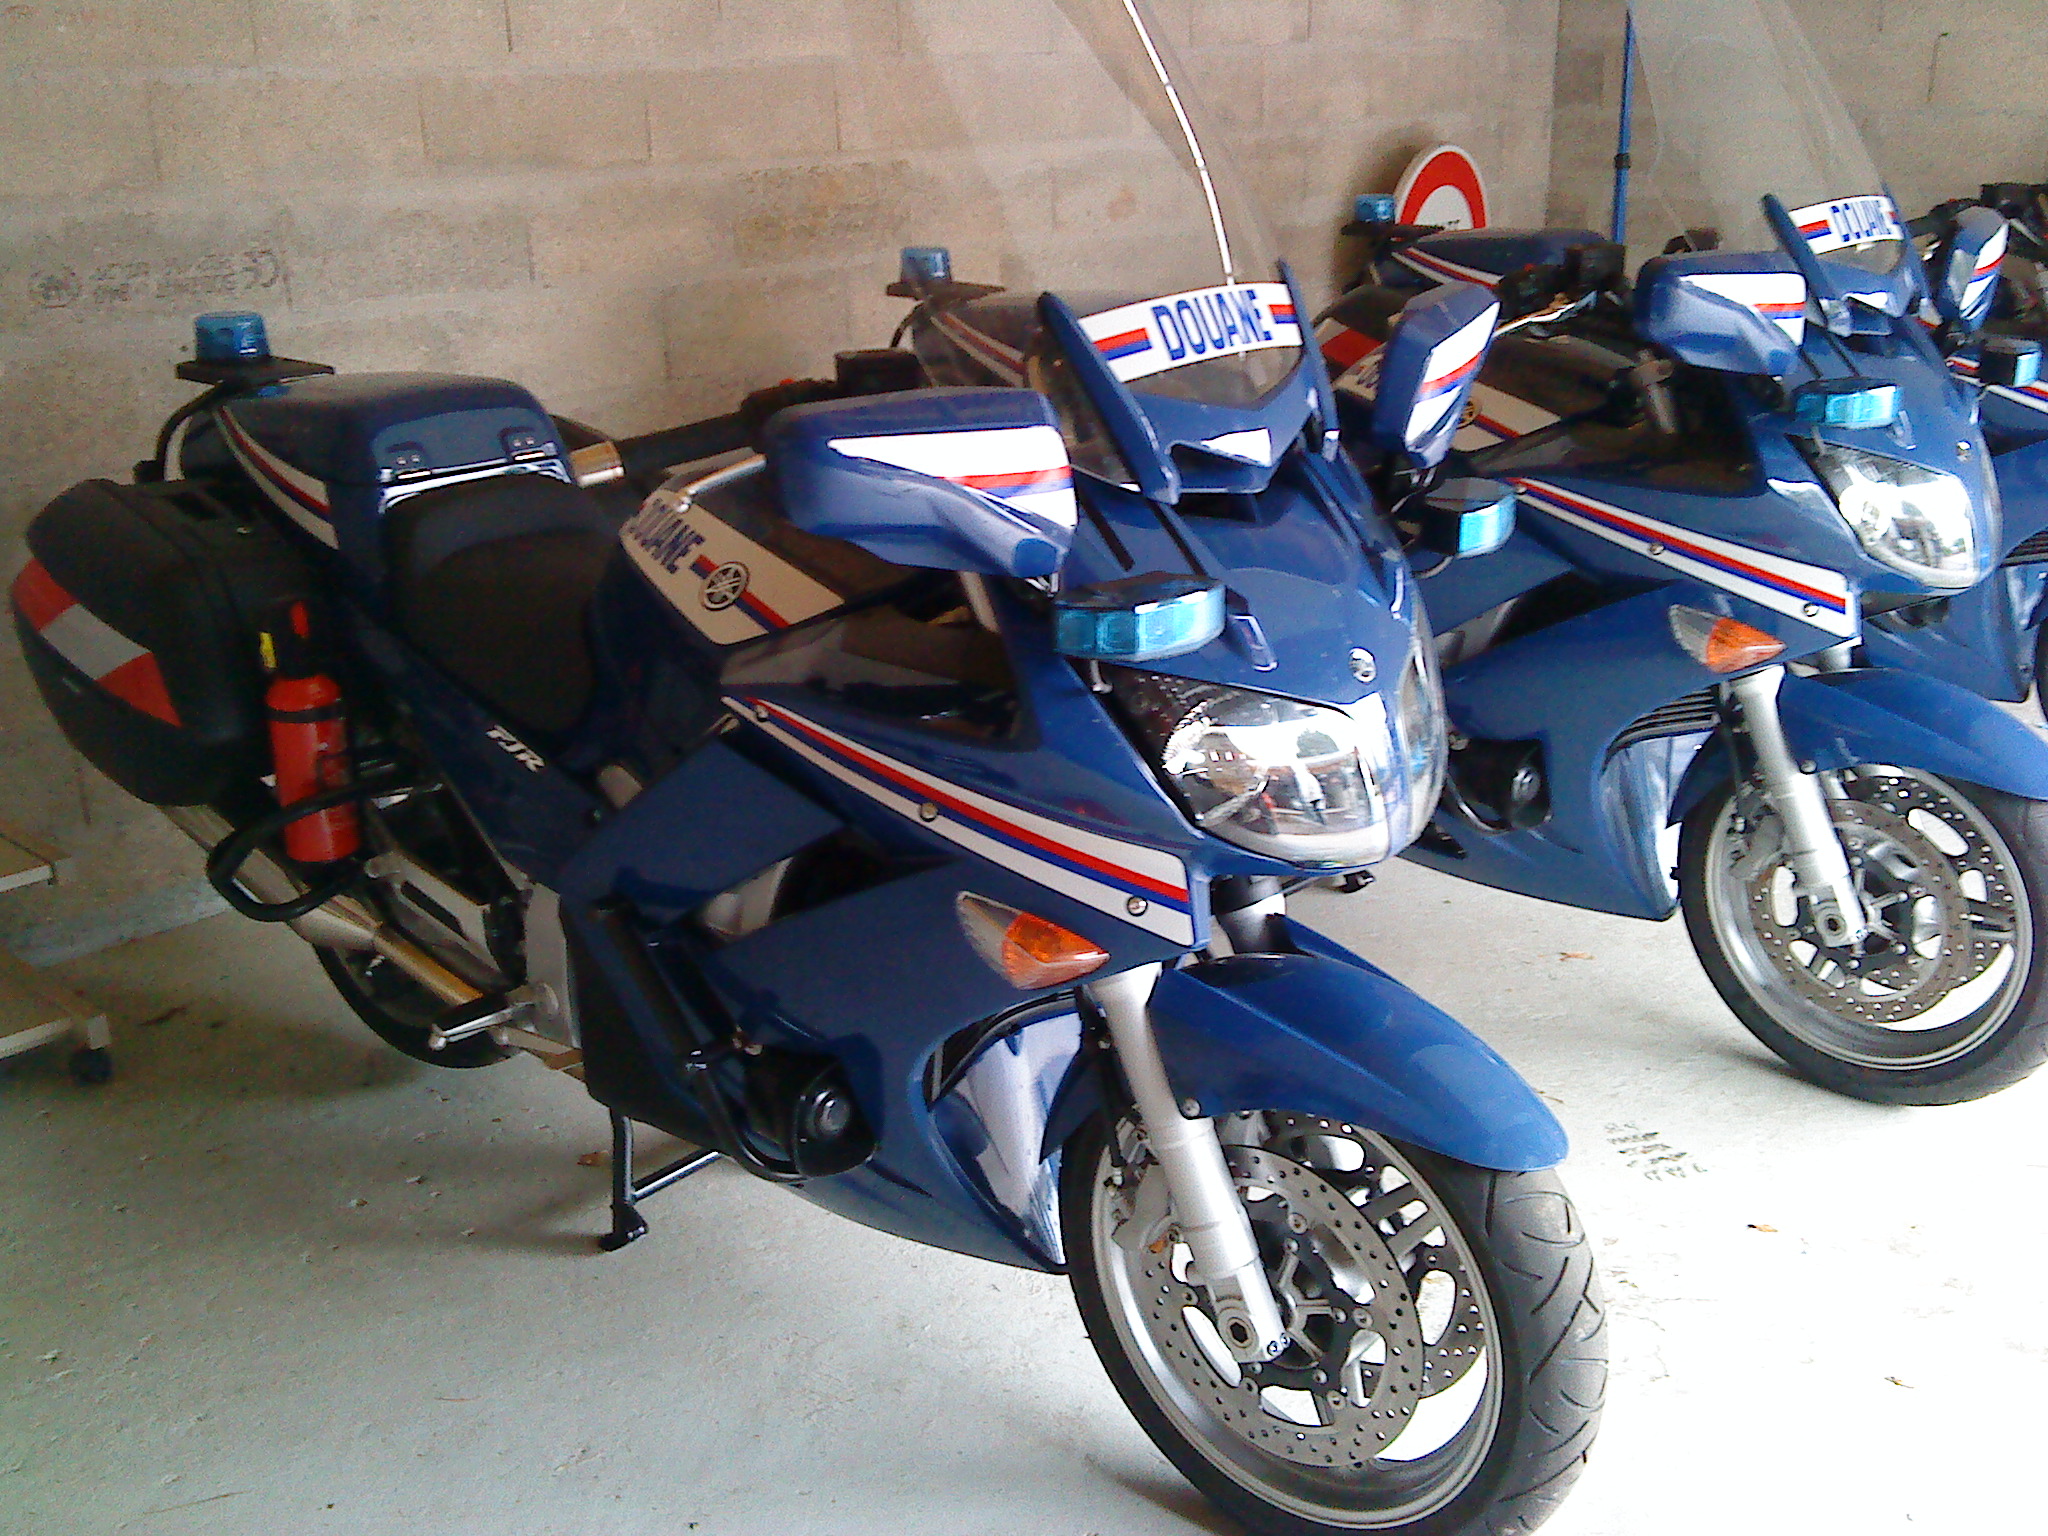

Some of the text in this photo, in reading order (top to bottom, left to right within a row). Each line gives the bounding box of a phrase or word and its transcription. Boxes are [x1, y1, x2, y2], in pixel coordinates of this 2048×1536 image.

[1829, 200, 1892, 242] DOUANE
[1151, 289, 1272, 361] DOUANE
[485, 724, 545, 773] FJR
